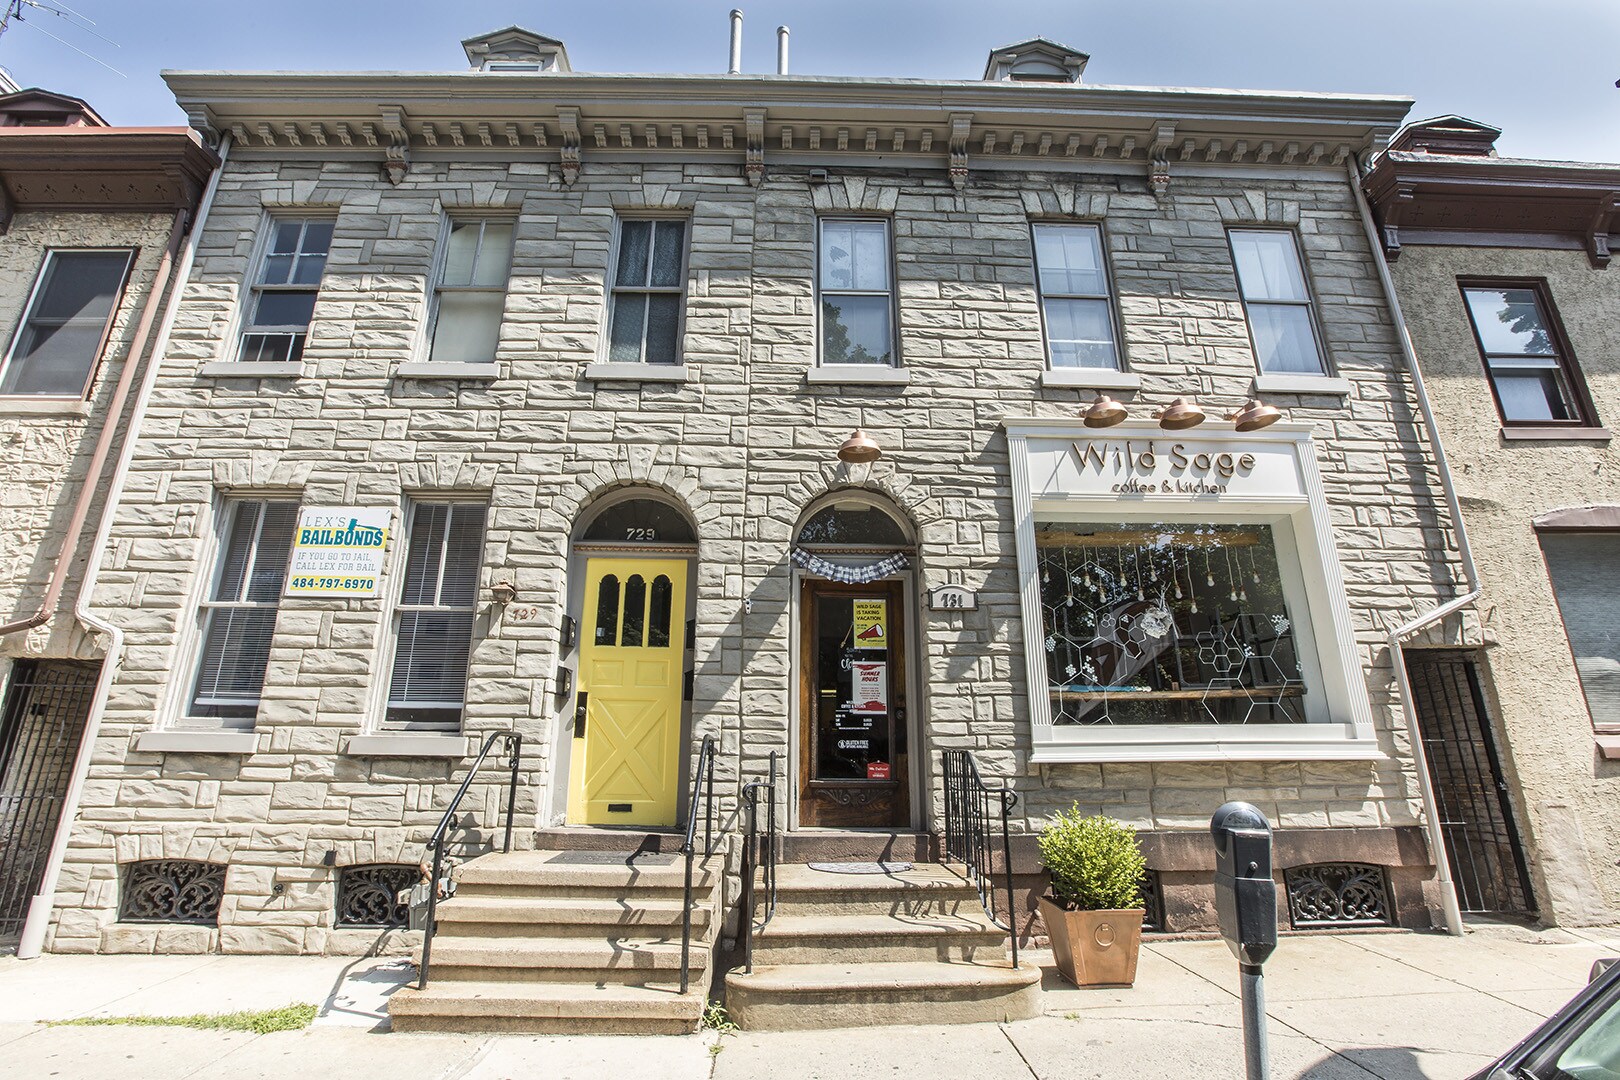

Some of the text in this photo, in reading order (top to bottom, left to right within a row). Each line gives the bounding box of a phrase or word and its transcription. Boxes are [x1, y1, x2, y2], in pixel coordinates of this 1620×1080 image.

[1072, 440, 1256, 477] Wild Sage
[1111, 478, 1228, 494] coffee & kitchen
[305, 516, 347, 528] LEX'S
[300, 529, 384, 547] BAILBONDS
[626, 527, 656, 541] 729
[297, 552, 307, 560] IF
[309, 552, 325, 561] YOU
[327, 552, 339, 561] GO
[340, 552, 352, 561] TO
[296, 562, 376, 572] CALL LEX FOR BAIL
[292, 577, 374, 590] 484-797-6970
[512, 608, 538, 621] 729
